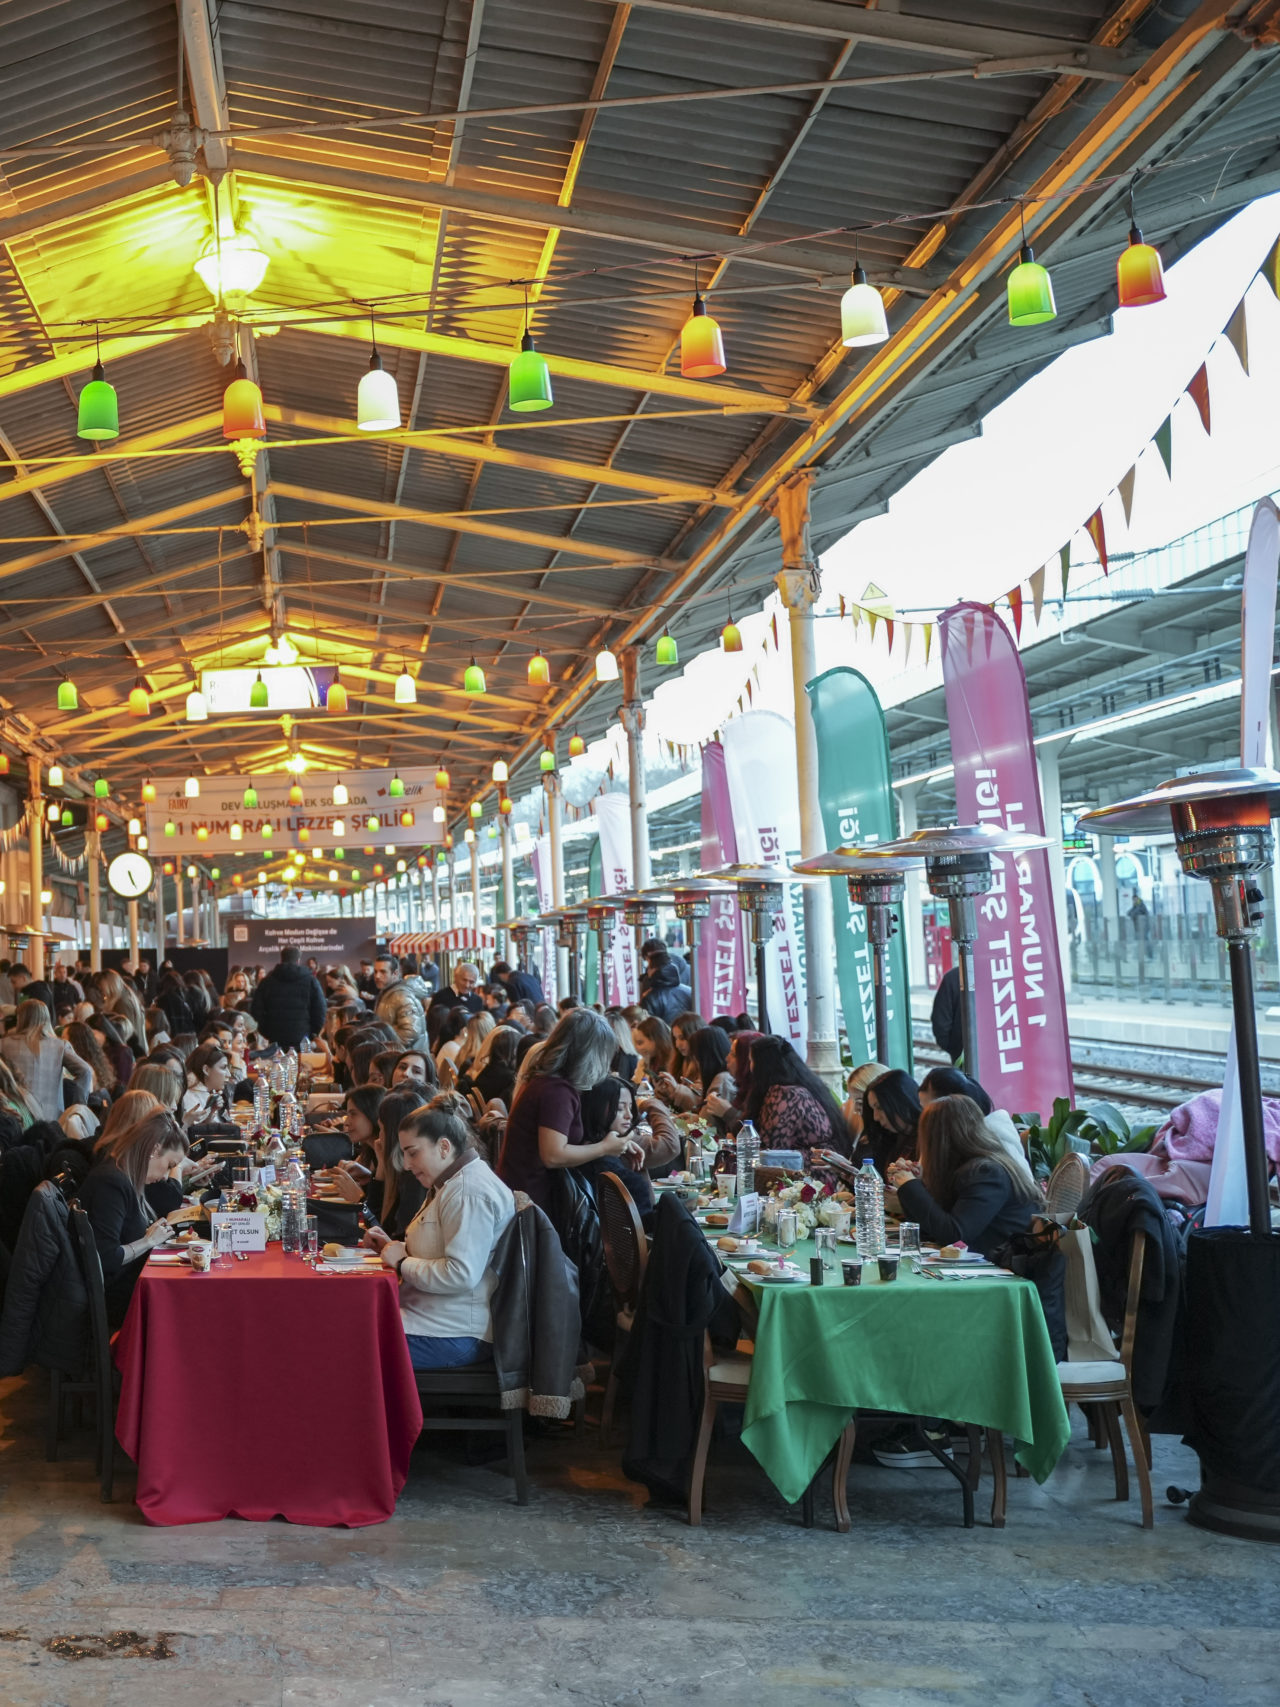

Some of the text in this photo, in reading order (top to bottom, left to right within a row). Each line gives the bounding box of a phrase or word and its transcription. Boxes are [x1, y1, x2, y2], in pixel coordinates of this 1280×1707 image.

[168, 798, 189, 810] FAIRY
[221, 796, 368, 811] DEV LUŞMA, EK SOADA
[177, 821, 183, 835] 1
[191, 818, 281, 835] NUMRALI
